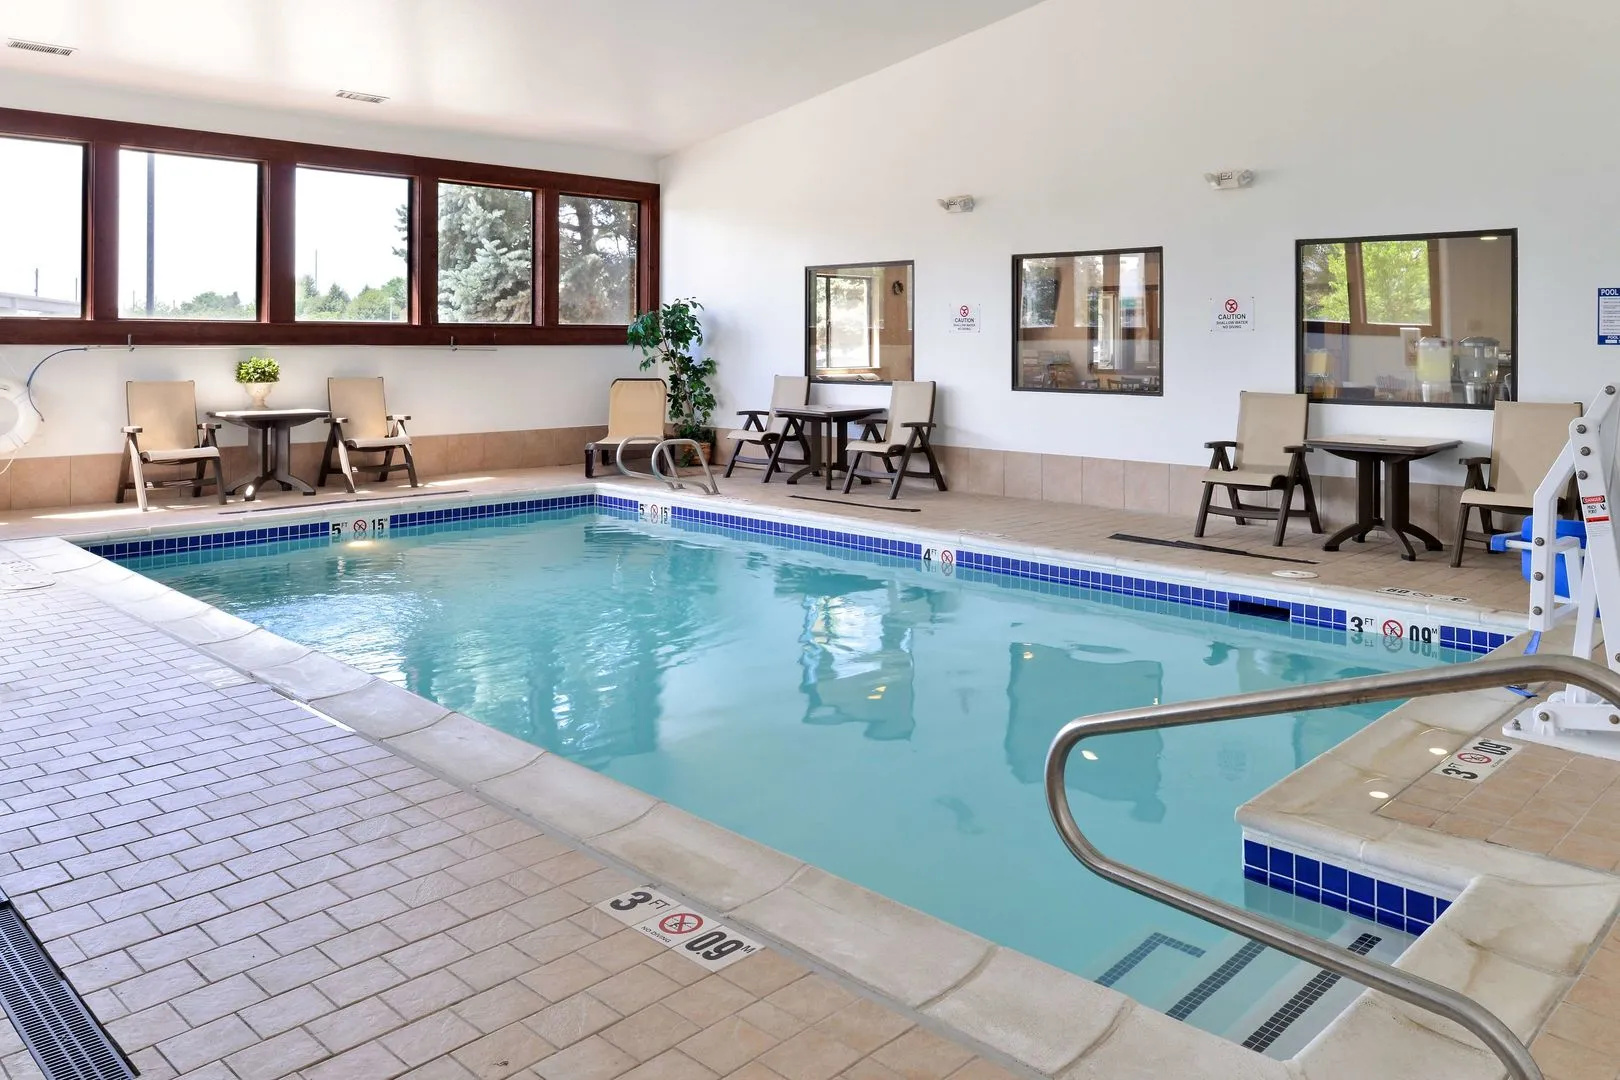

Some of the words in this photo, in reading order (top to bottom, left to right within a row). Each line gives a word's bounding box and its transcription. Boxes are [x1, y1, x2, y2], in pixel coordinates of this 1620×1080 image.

[332, 523, 341, 534] 5
[924, 549, 931, 560] 4
[1350, 616, 1363, 632] 3
[1364, 618, 1374, 626] FT
[610, 891, 653, 911] 3
[649, 899, 671, 910] FT
[650, 931, 672, 943] DIVING
[685, 931, 744, 960] 0.9
[741, 945, 756, 954] M
